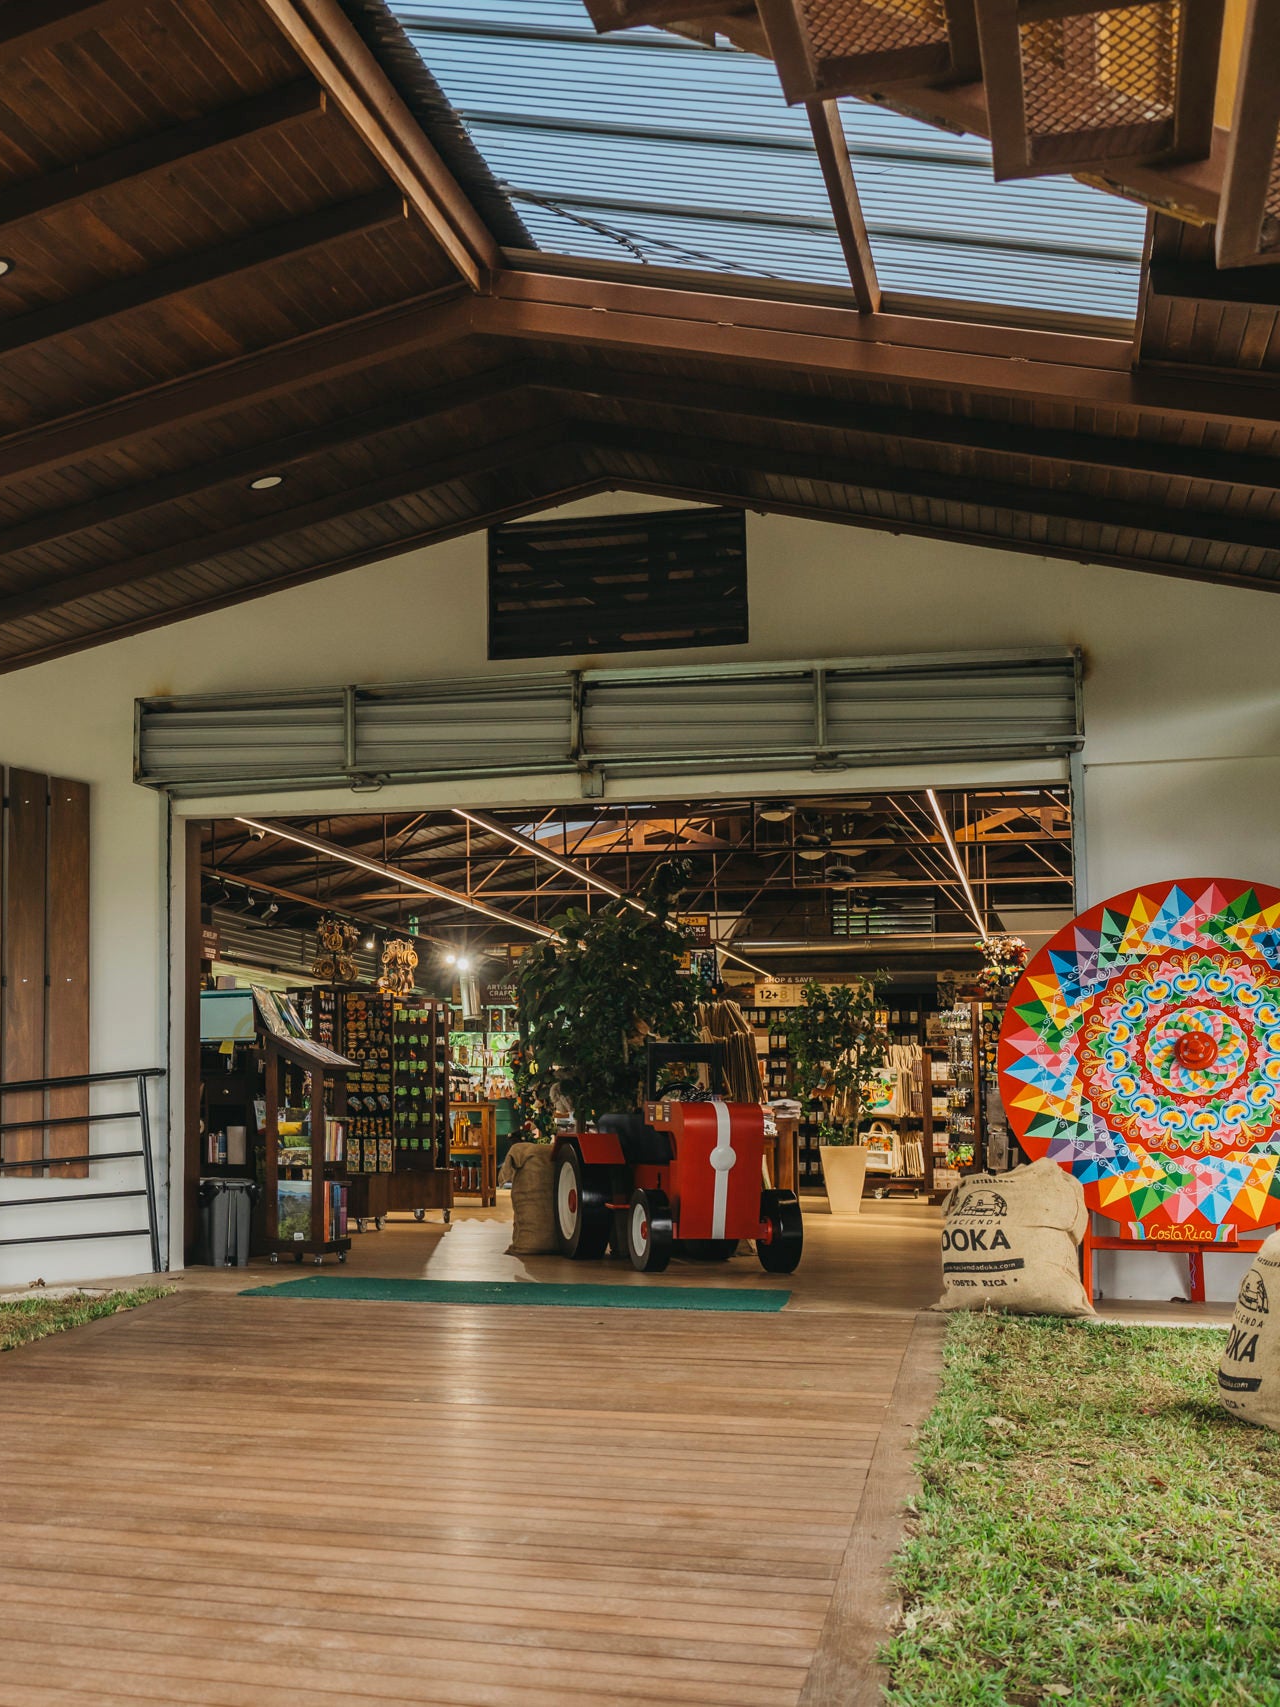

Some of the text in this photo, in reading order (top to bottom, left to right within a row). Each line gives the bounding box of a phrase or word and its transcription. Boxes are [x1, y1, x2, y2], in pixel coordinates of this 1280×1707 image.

[941, 1229, 1011, 1252] DOKA
[1146, 1224, 1214, 1240] Costa Rica
[982, 1279, 1008, 1287] RICA
[1226, 1323, 1260, 1363] OKA
